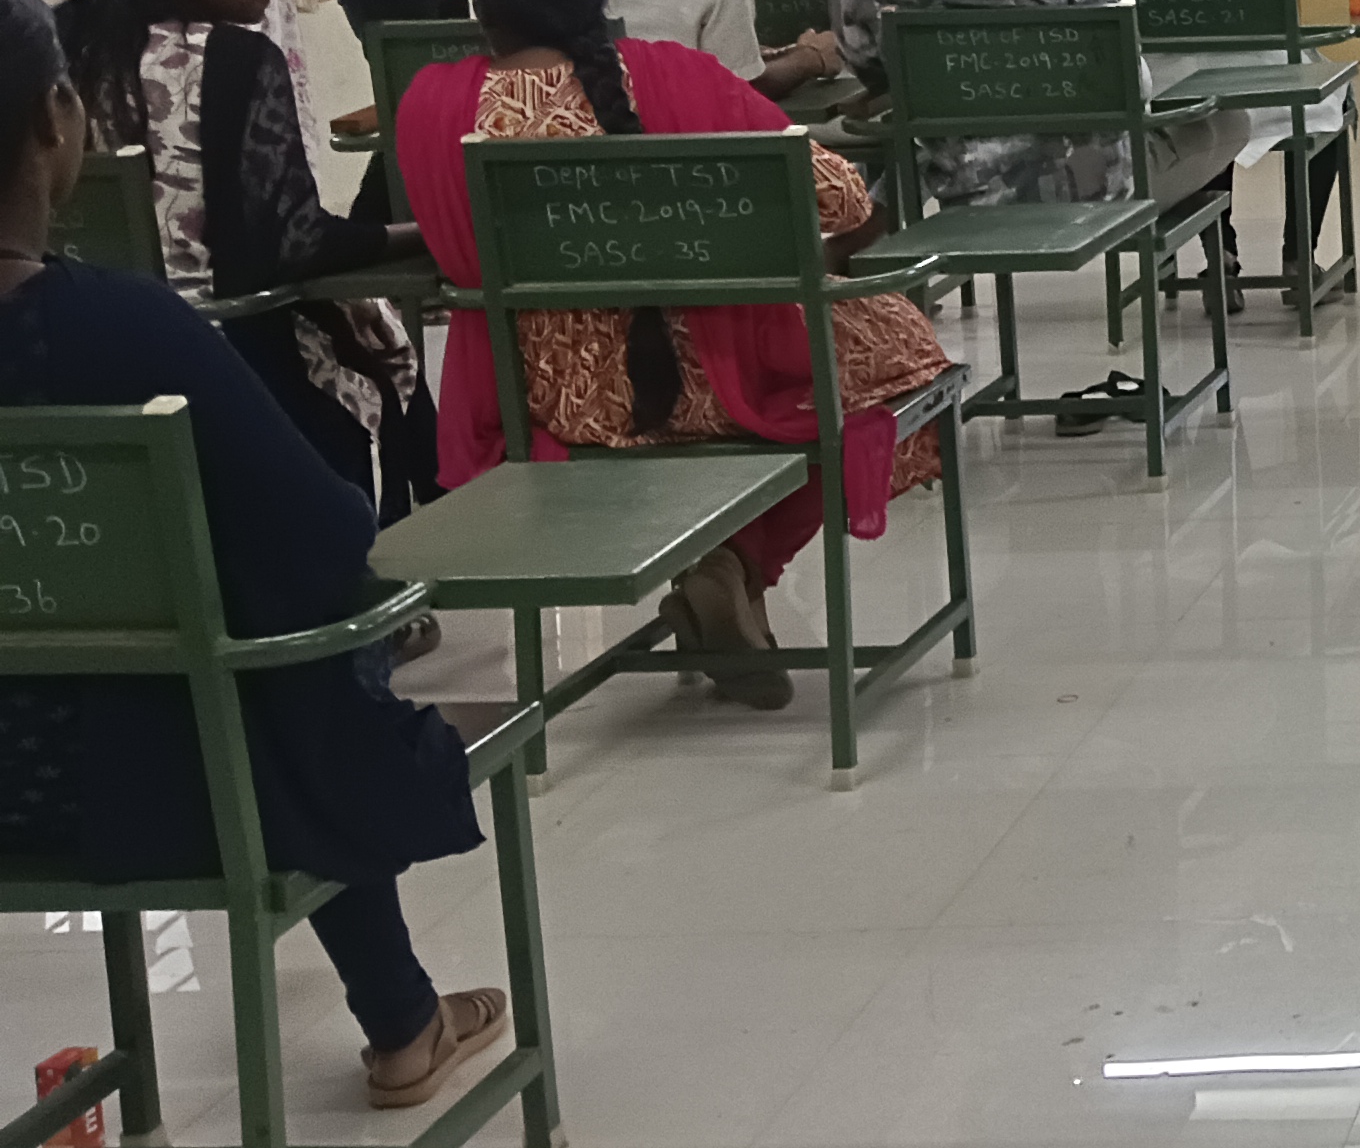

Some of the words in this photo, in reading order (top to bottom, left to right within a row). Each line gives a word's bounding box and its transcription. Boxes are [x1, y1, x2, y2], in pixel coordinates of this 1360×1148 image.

[1148, 9, 1208, 27] SASC
[960, 81, 1023, 101] SASC
[1041, 80, 1078, 98] 28
[533, 164, 602, 190] Dept
[651, 163, 740, 188] TSD
[546, 202, 618, 228] FMC
[559, 240, 647, 269] SASC
[674, 240, 711, 263] 35
